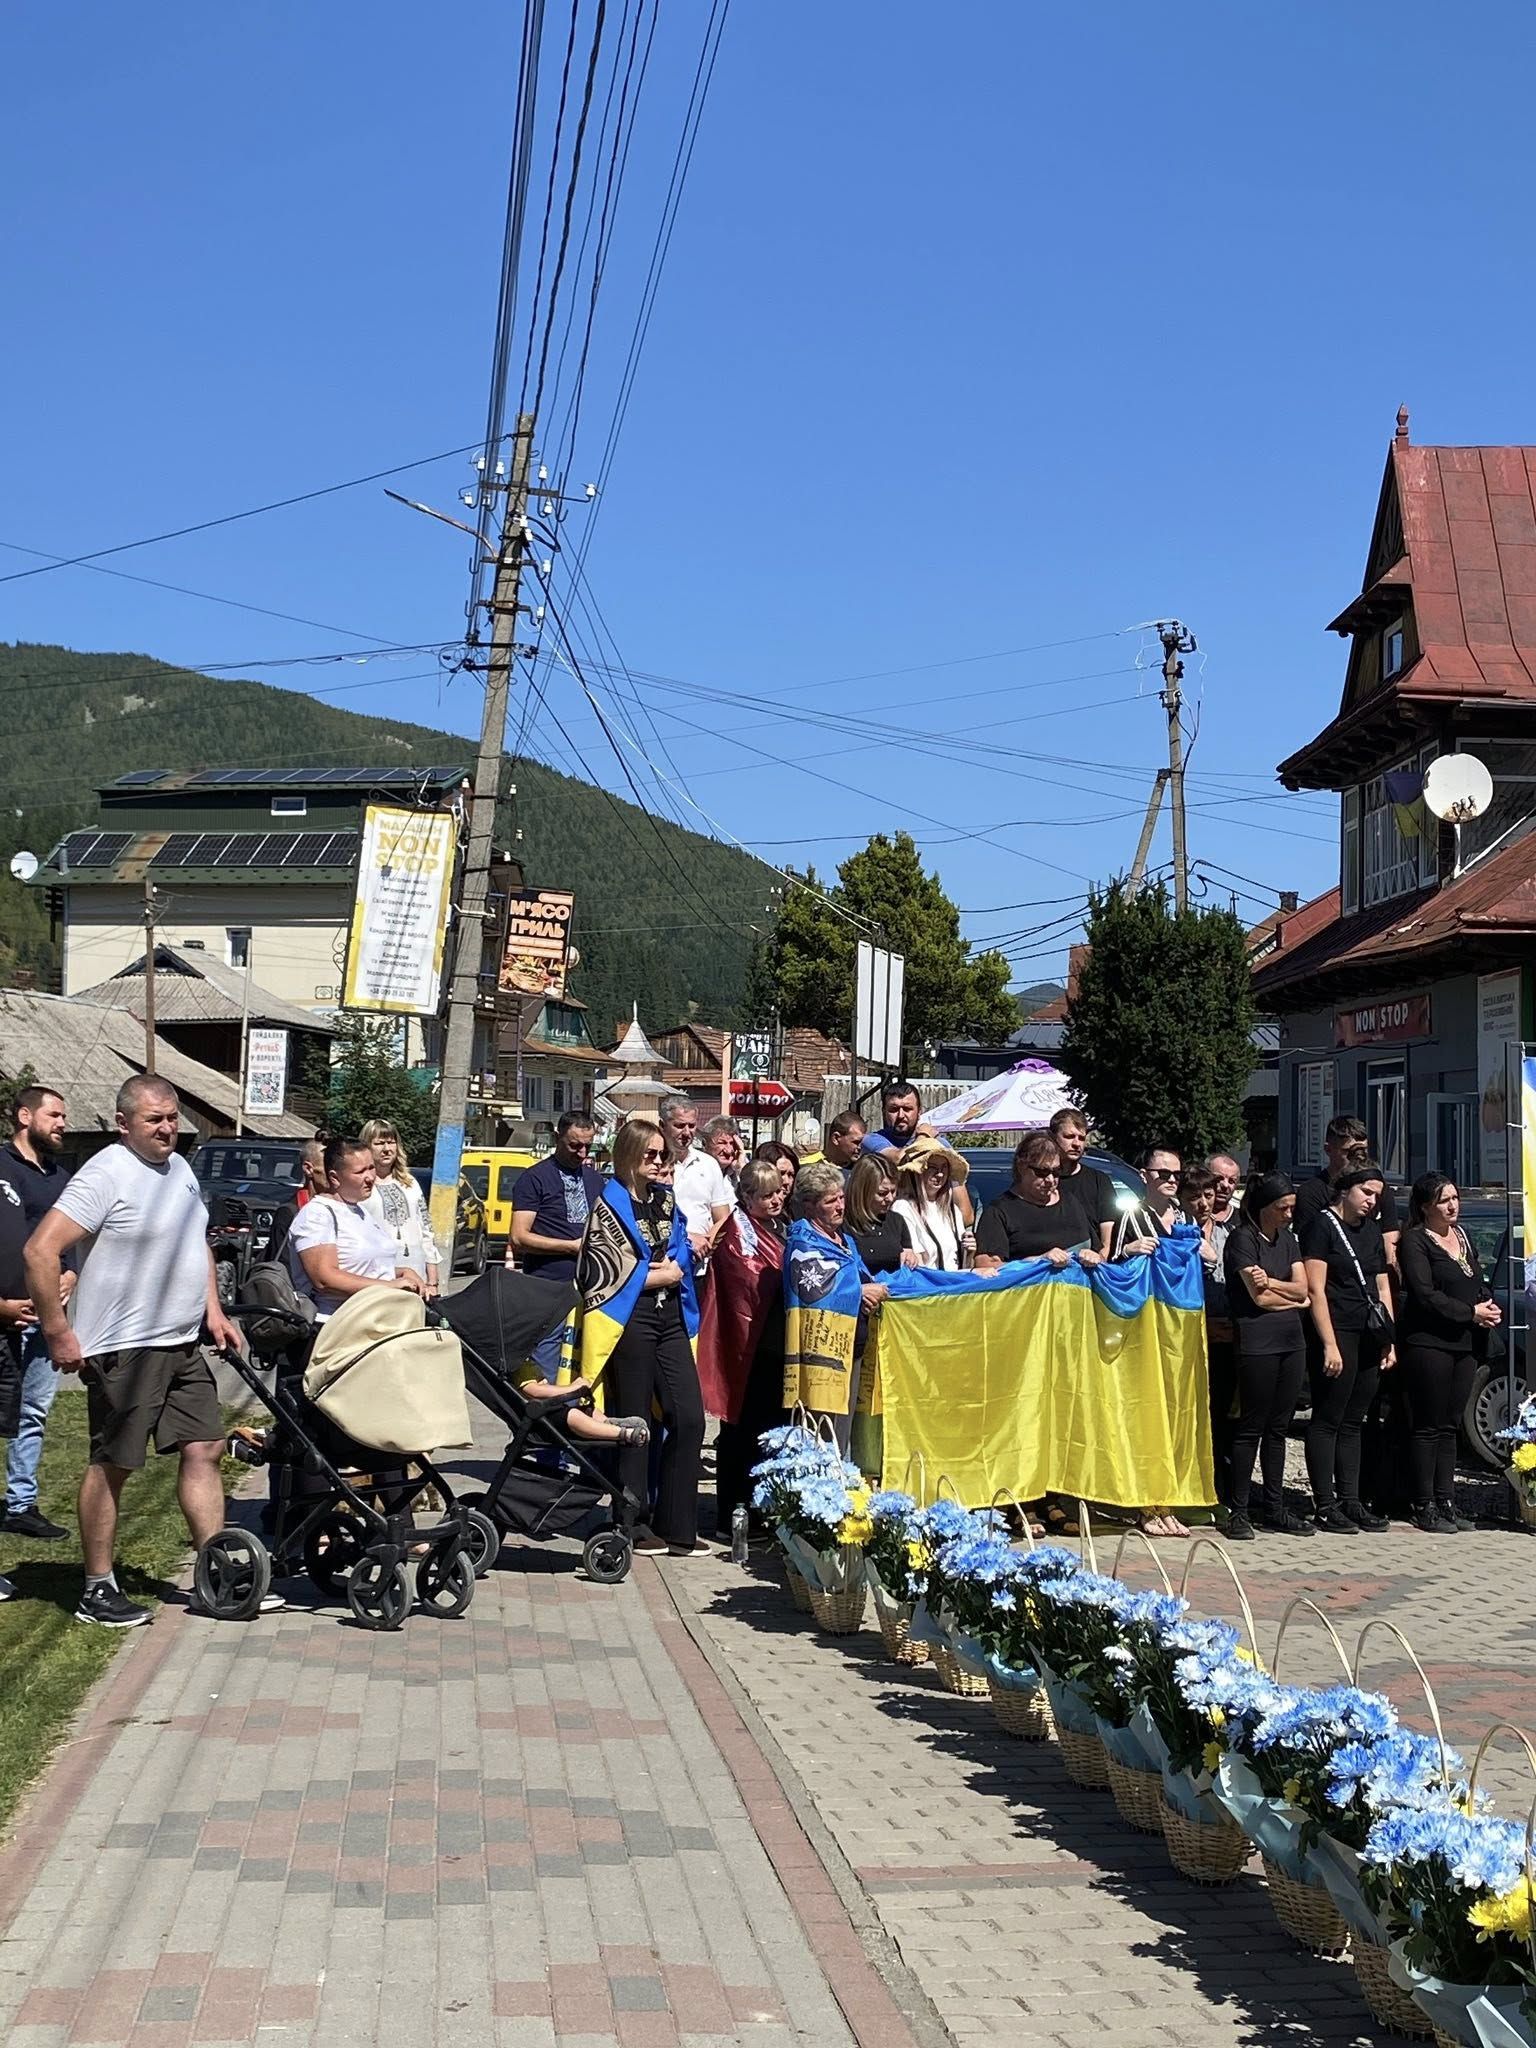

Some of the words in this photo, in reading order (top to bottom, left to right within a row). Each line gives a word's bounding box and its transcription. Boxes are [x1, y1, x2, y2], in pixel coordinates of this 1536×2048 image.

[378, 832, 440, 855] NON
[375, 853, 439, 874] STOP
[510, 899, 570, 921] М'ЯСО
[510, 917, 565, 938] ГРИЛЬ
[1356, 1009, 1376, 1033] NON
[1381, 1003, 1408, 1028] STOP
[735, 1037, 770, 1053] ЧАН
[728, 1092, 755, 1105] NON
[758, 1094, 789, 1106] STOP
